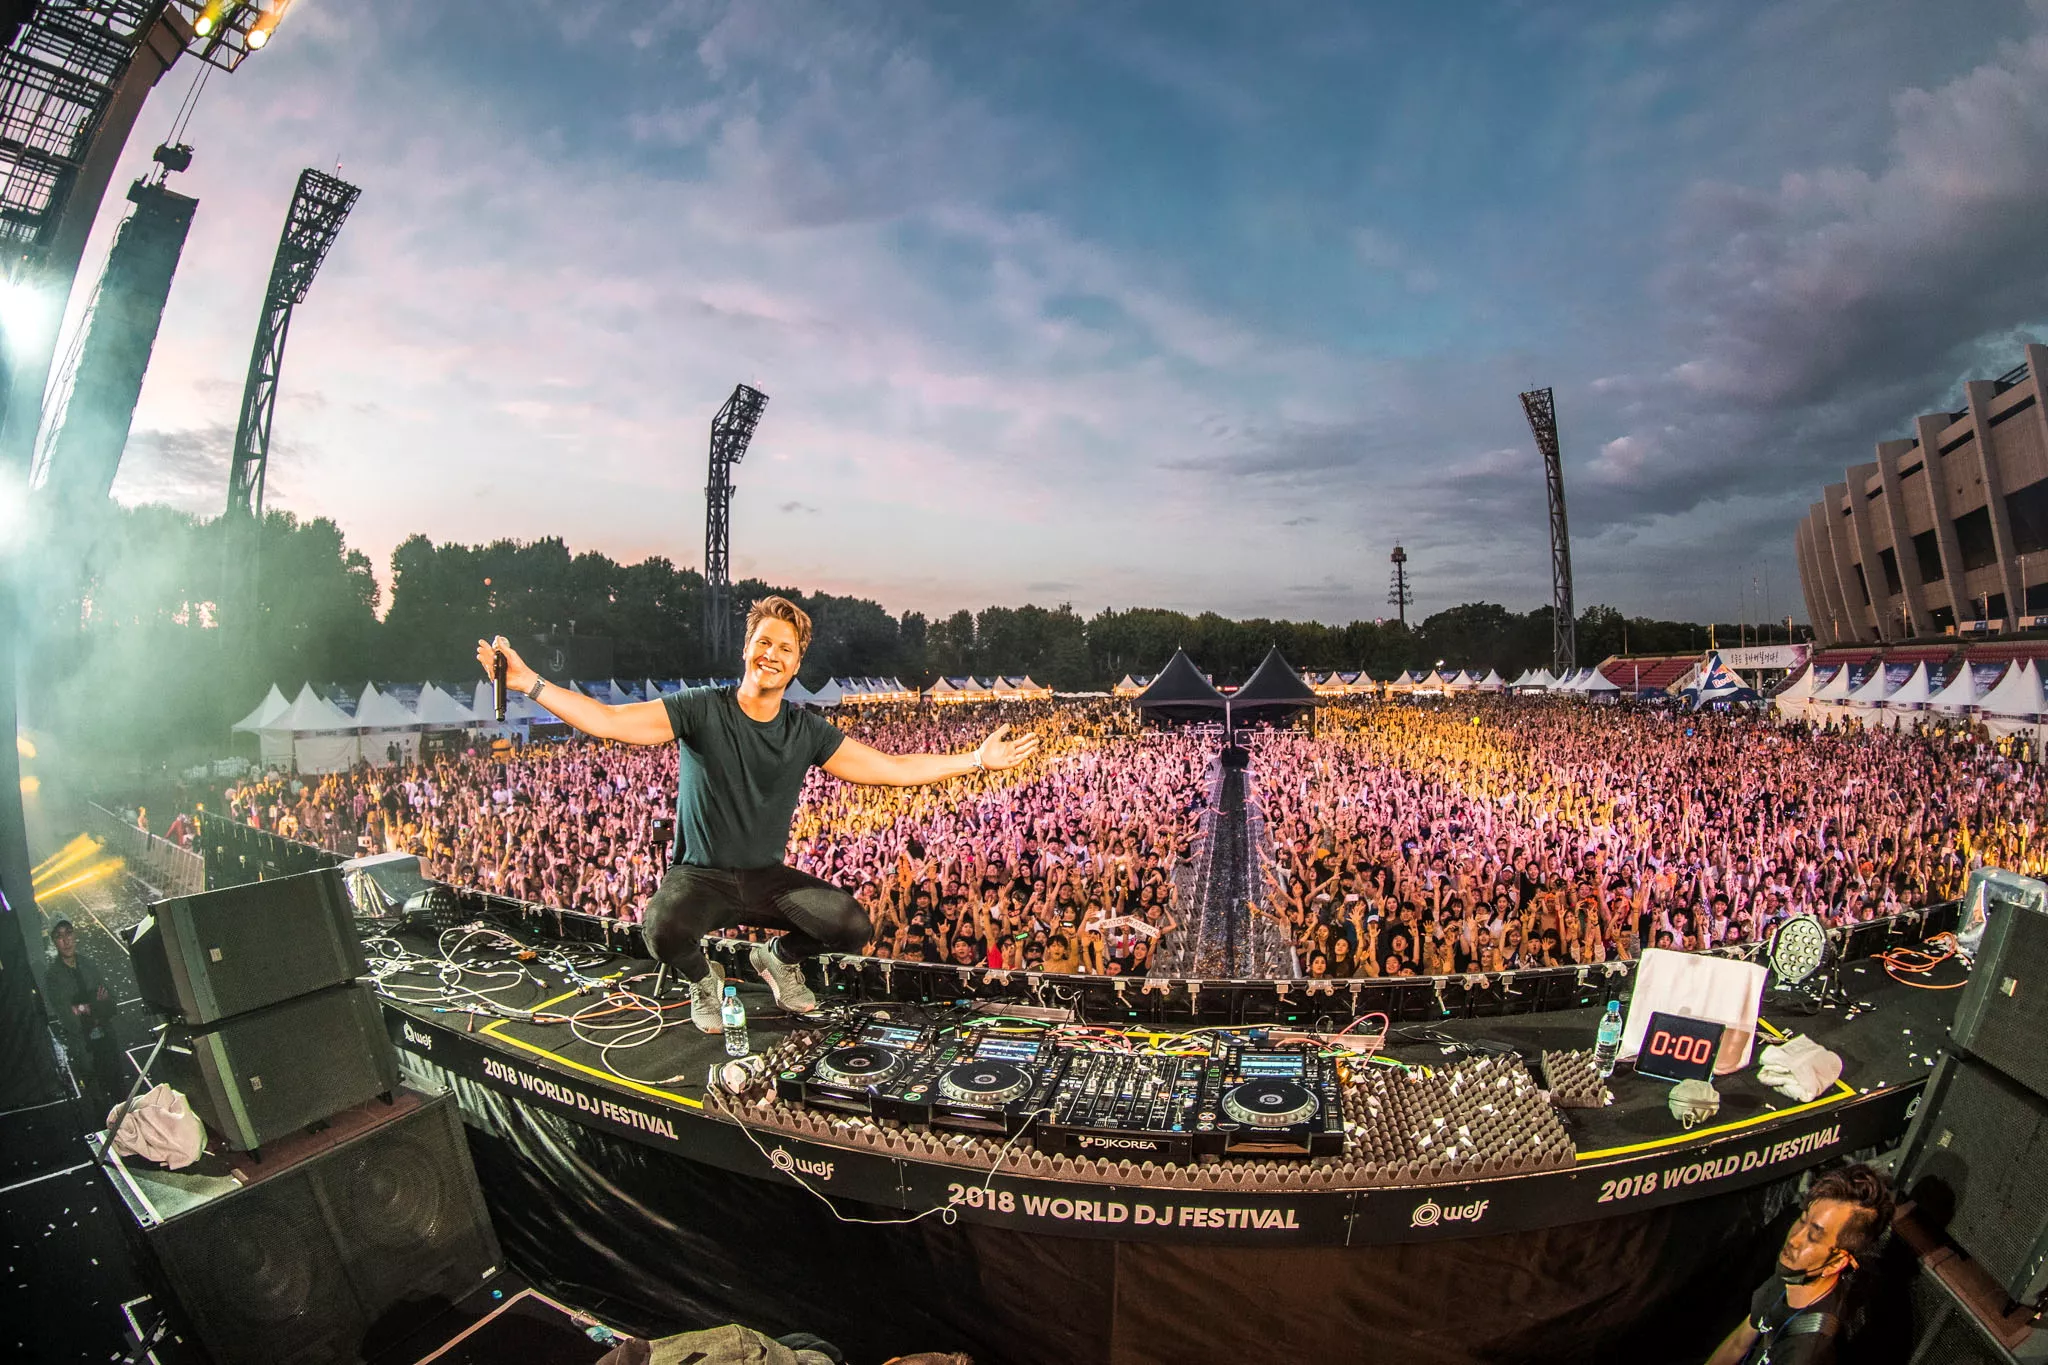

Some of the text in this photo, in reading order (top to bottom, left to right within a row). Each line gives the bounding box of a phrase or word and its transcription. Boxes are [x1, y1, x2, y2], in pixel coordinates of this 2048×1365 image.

[1650, 1031, 1711, 1064] 0:00
[483, 1057, 679, 1141] 2018 WORLD DJ FESTIVAL
[1094, 1138, 1157, 1150] DJKOREA
[1597, 1124, 1842, 1203] 2018 WORLD DJ FESTIVAL
[947, 1183, 1300, 1230] 2018 WORLD DJ FESTIVAL
